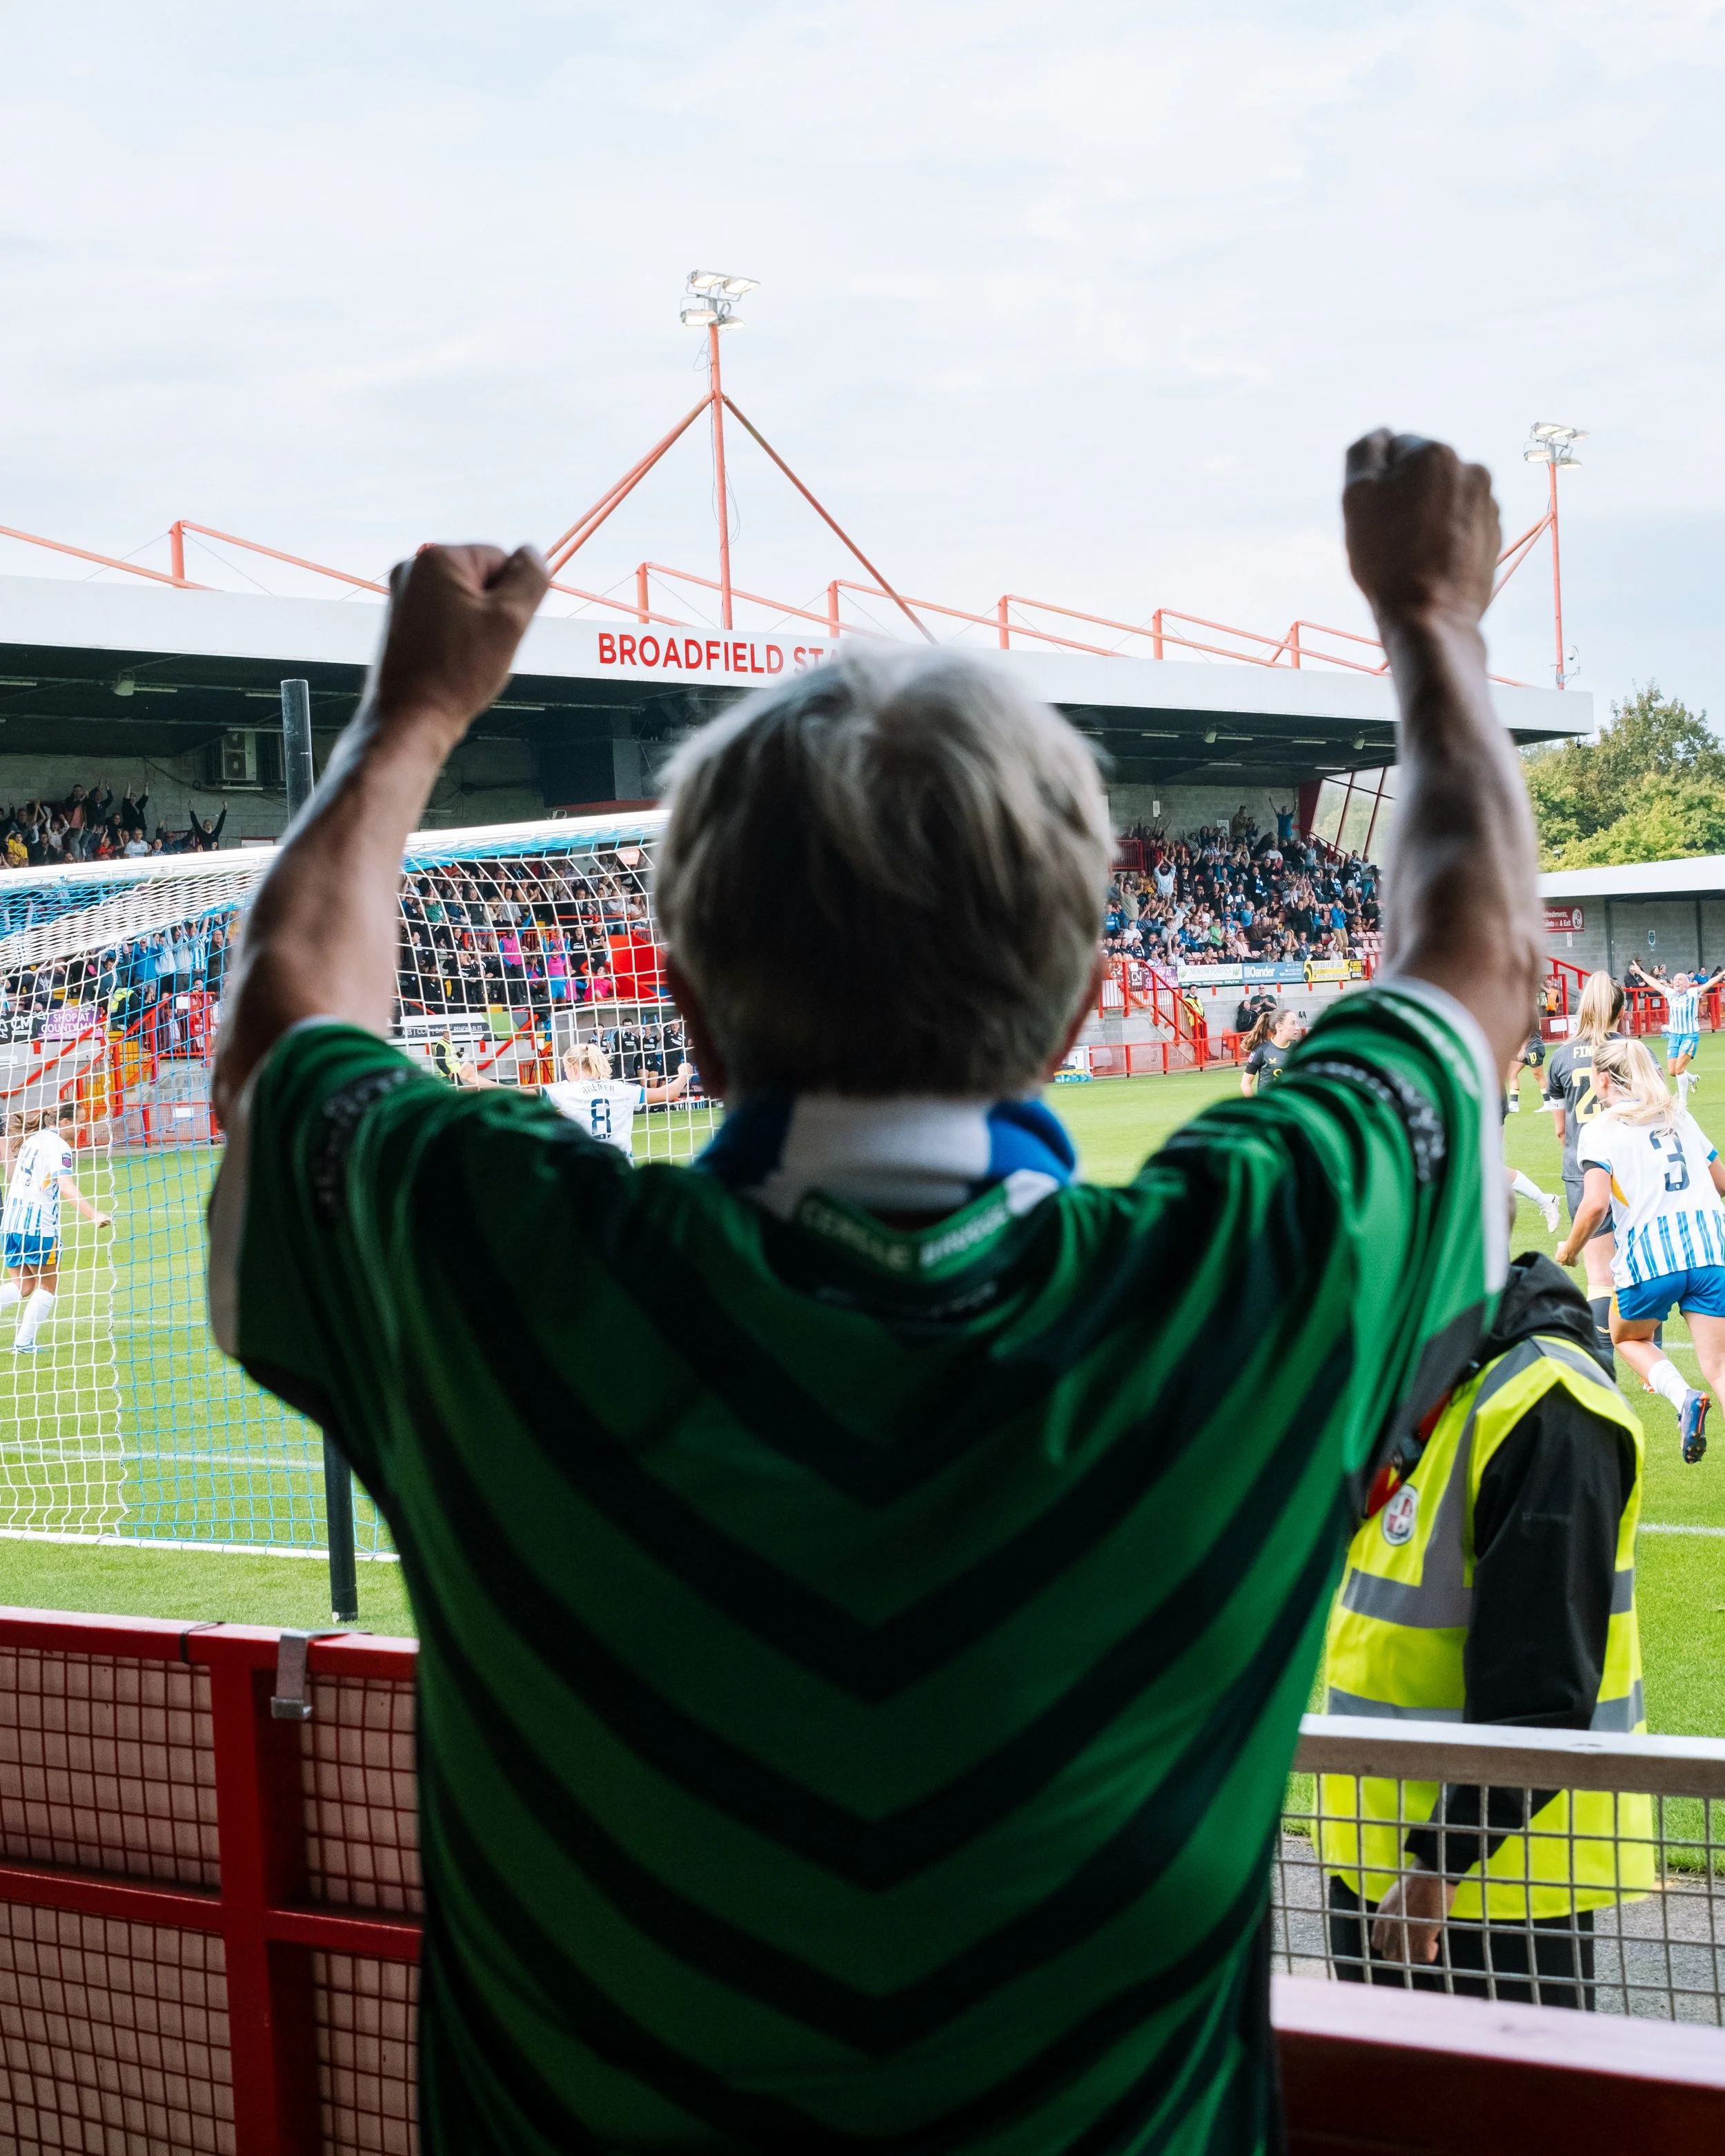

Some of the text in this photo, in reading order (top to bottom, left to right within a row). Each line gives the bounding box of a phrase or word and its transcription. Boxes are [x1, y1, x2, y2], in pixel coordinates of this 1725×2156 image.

[598, 632, 784, 674] BROADFIELD
[41, 1024, 79, 1034] COUNTY
[53, 1013, 90, 1022] SHOP AT
[1573, 1045, 1594, 1059] FIN
[1572, 1067, 1601, 1124] 2
[591, 1098, 612, 1140] 8
[1649, 1128, 1690, 1192] 3
